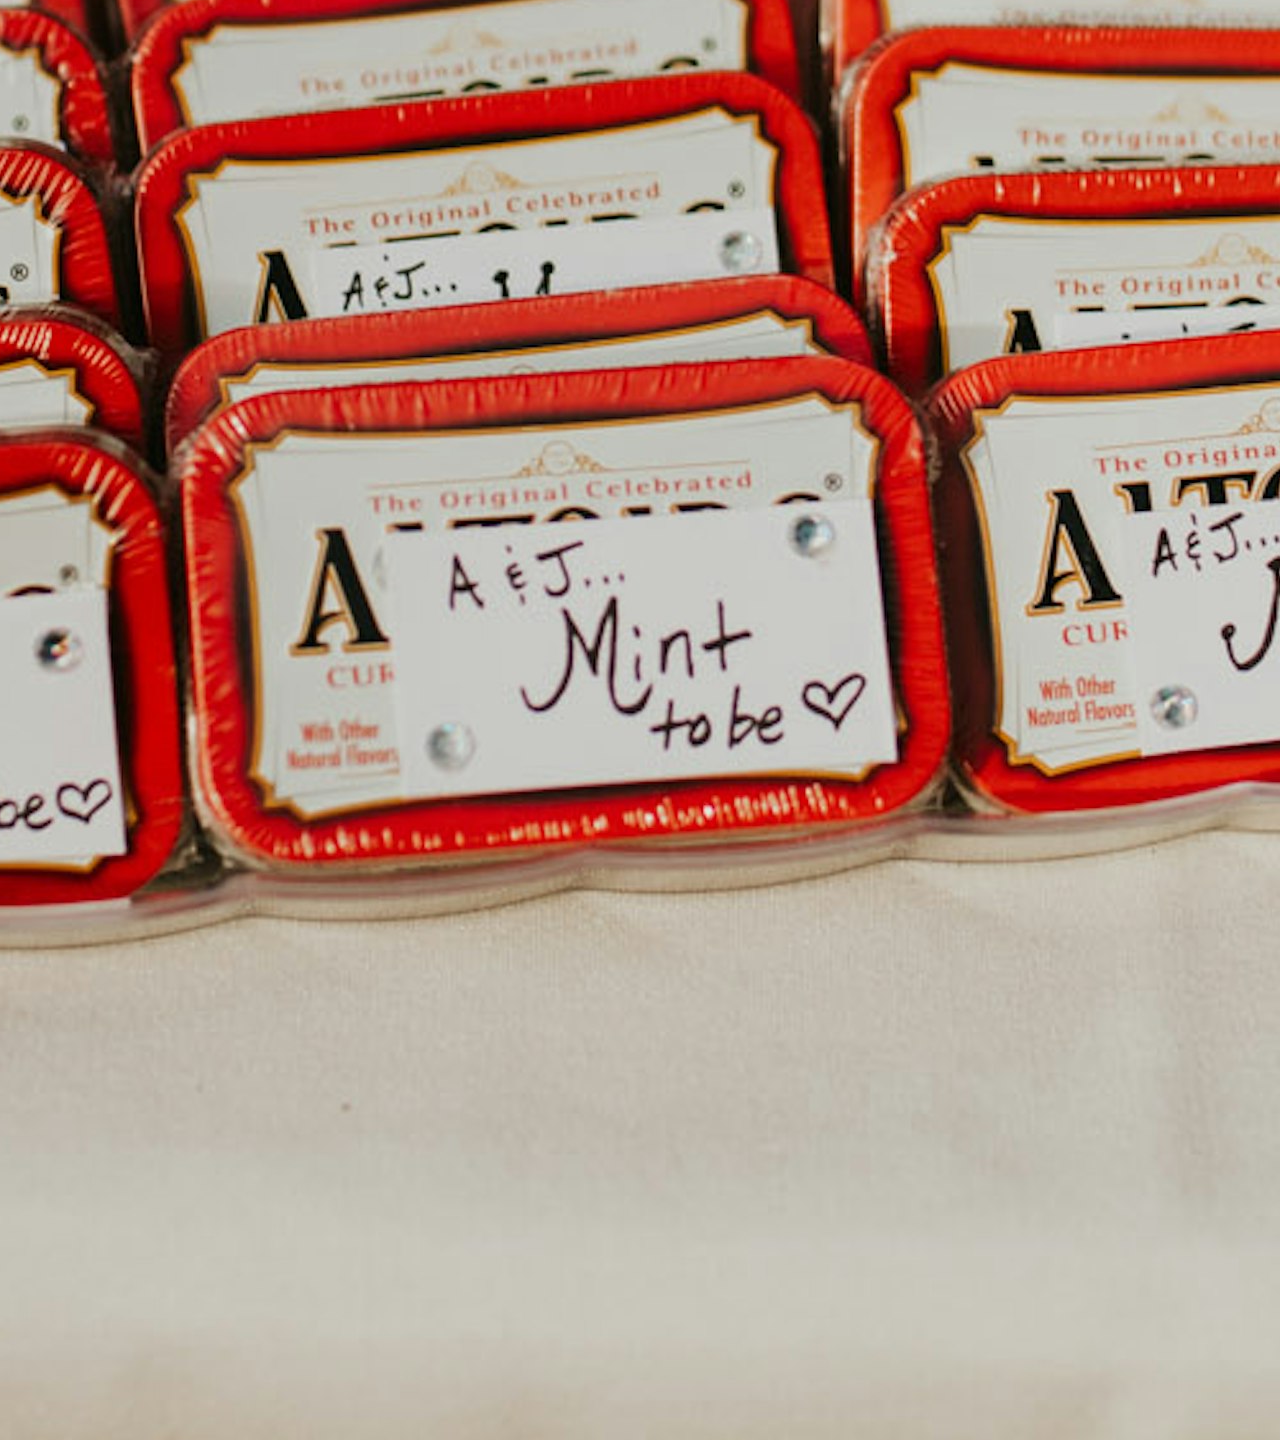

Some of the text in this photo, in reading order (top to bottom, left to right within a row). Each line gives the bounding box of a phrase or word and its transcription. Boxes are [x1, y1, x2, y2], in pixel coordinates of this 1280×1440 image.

[360, 59, 476, 92] Original
[489, 38, 638, 74] Celebrated
[1017, 128, 1068, 148] The
[1081, 128, 1197, 152] Original
[305, 180, 662, 237] The Original Celebrated
[1054, 277, 1106, 297] The
[1119, 272, 1242, 297] Original
[1094, 455, 1148, 477] The
[366, 468, 754, 517] The Original Celebrated
[519, 594, 754, 717] Mint
[1038, 673, 1117, 702] With Other
[650, 683, 786, 751] to be
[1026, 699, 1136, 727] Natural Flavors
